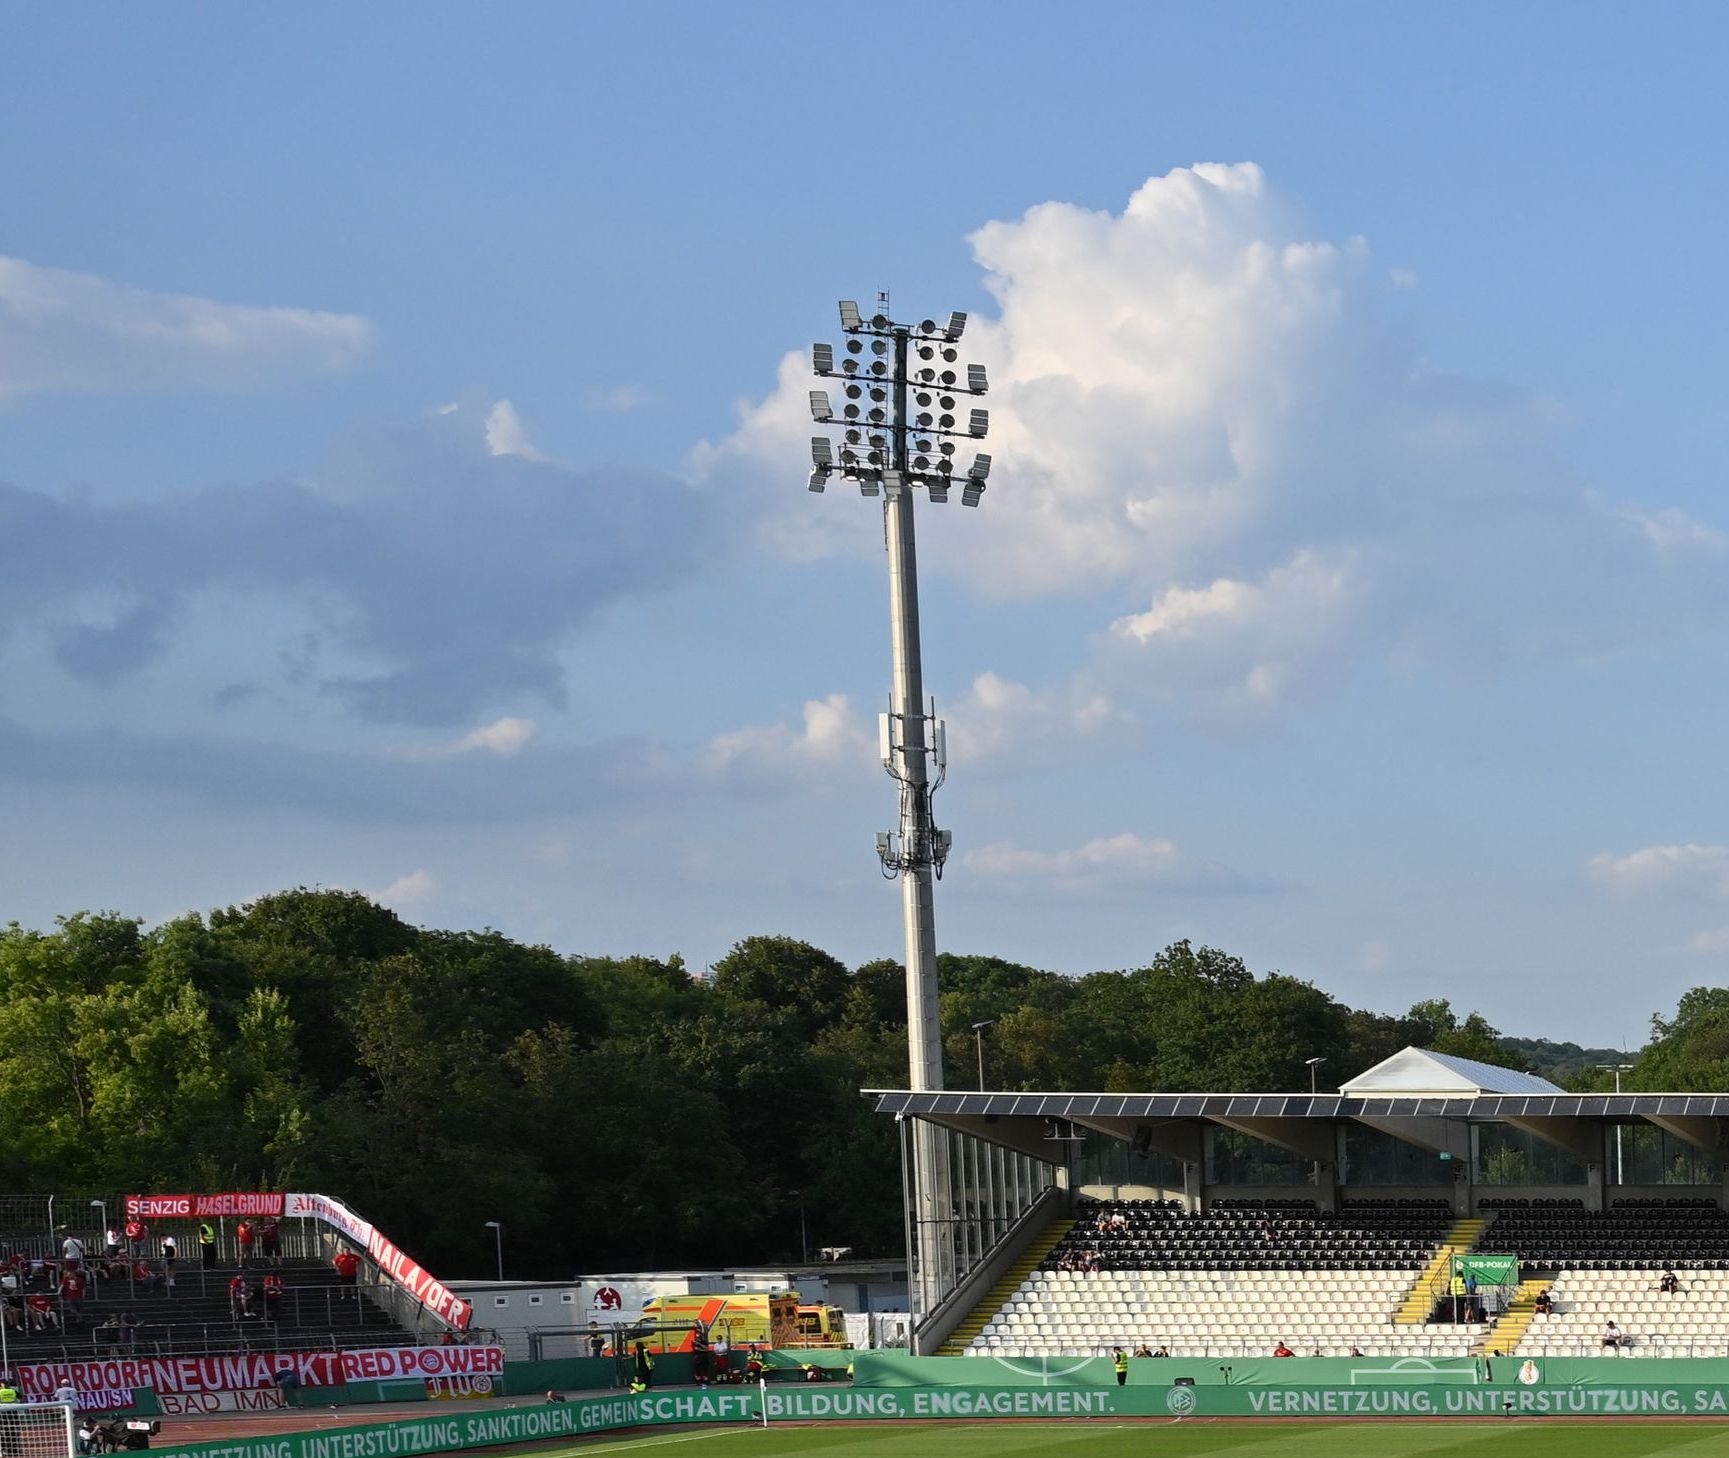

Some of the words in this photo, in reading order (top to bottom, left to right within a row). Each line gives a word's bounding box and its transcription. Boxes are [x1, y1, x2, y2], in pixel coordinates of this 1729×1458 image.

[127, 1200, 190, 1215] SENZIG
[195, 1194, 282, 1215] HASELGRUND
[17, 1361, 152, 1397] ROHRDORF
[152, 1352, 339, 1393] NEUMARKT
[344, 1351, 396, 1380] RED
[400, 1348, 502, 1376] POWER
[163, 1393, 221, 1415] BAD
[1248, 1391, 1438, 1415] VERNETZUNG,
[1445, 1385, 1687, 1414] UNTERSTÜTZUNG,
[467, 1411, 578, 1444] SANKTIONEN,
[768, 1392, 905, 1419] BILDUNG,
[914, 1391, 1115, 1415] ENGAGEMENT.
